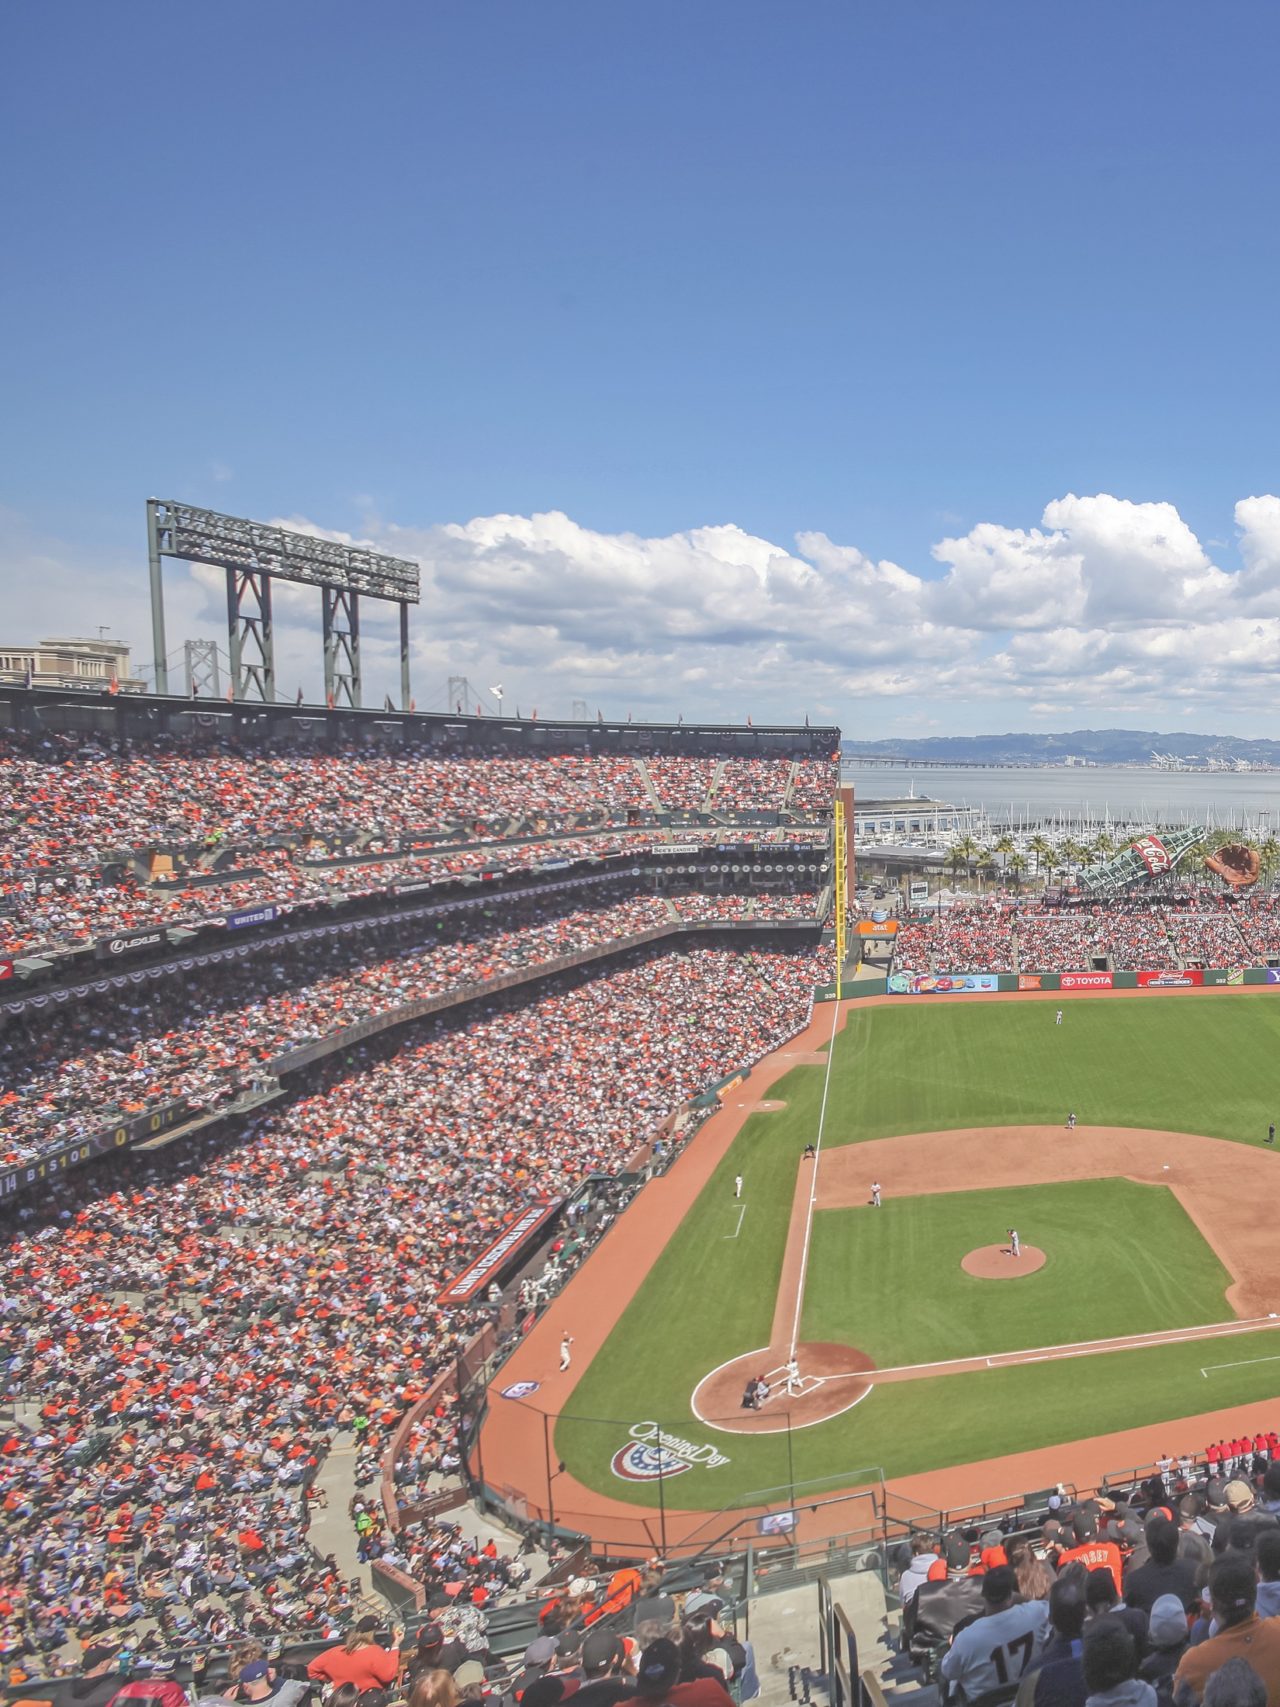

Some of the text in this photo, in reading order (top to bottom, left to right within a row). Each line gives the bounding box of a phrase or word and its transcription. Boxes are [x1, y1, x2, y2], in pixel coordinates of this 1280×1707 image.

[234, 913, 264, 926] UNITED
[123, 934, 161, 950] LEXUS
[1076, 976, 1112, 985] TOYOTA
[4, 1173, 17, 1193] 14
[26, 1168, 36, 1182] B
[38, 1164, 46, 1177] 1
[49, 1158, 57, 1172] S
[59, 1155, 67, 1168] 1
[628, 1420, 732, 1469] Opening Day
[989, 1629, 1035, 1685] 17
